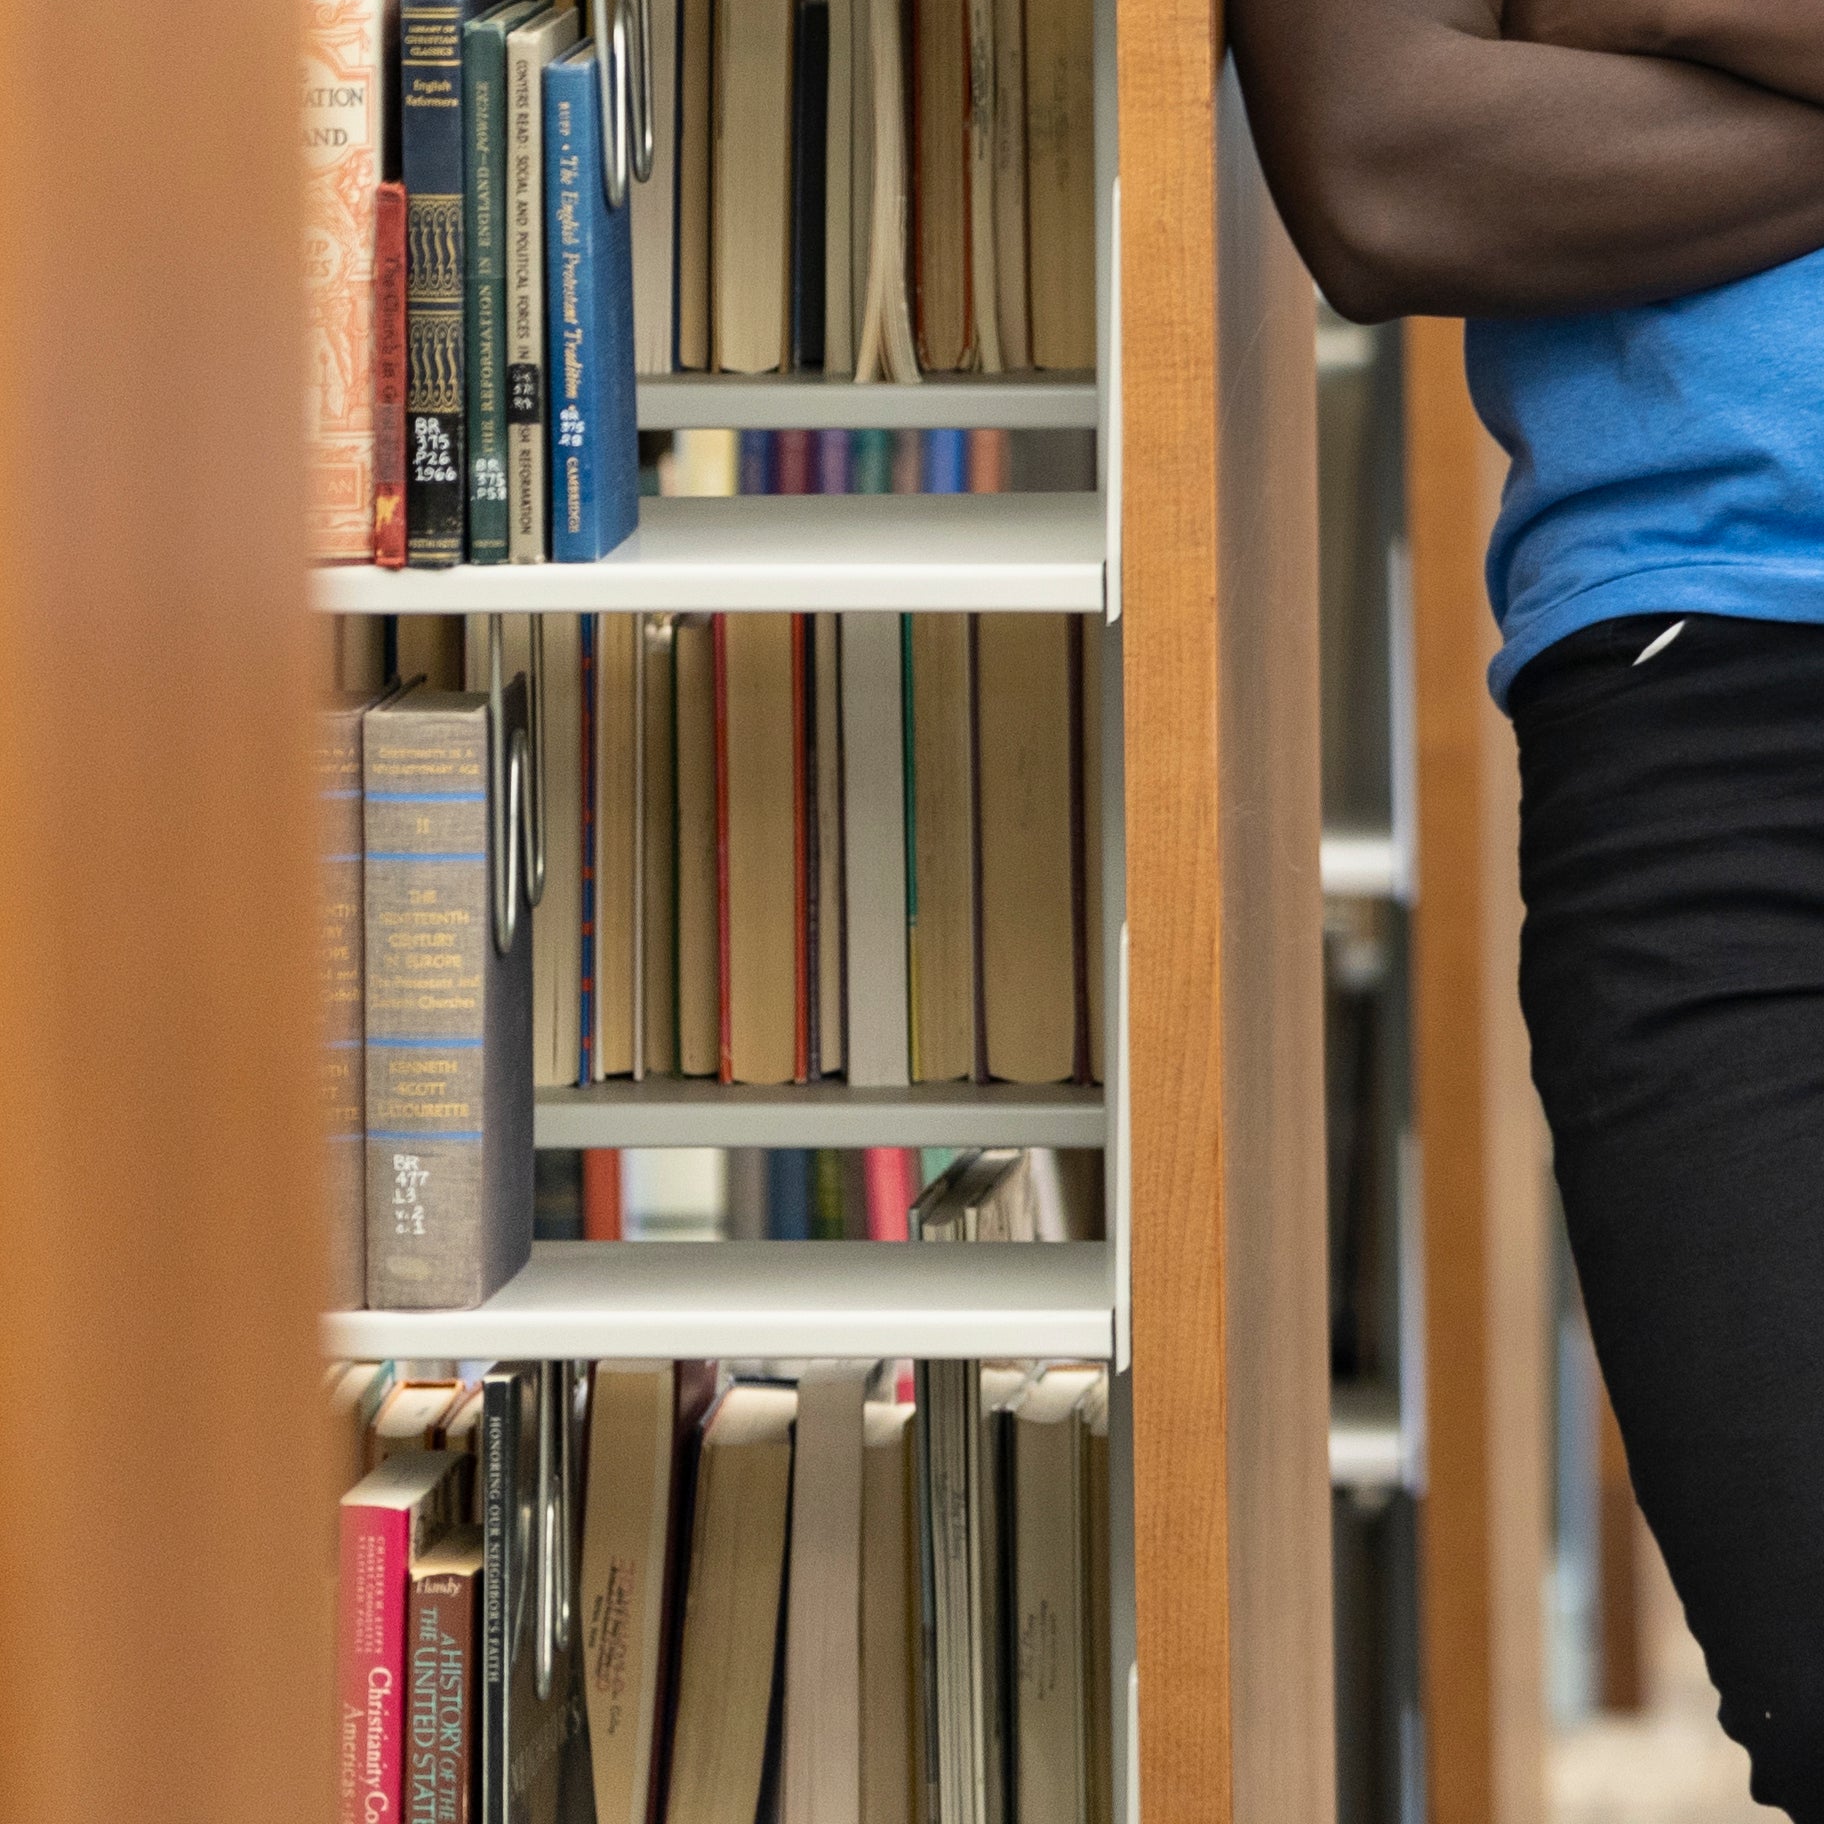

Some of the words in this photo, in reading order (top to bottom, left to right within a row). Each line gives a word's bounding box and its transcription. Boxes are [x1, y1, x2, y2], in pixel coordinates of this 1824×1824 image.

[413, 79, 451, 93] English
[516, 59, 530, 107] CONYERS
[405, 97, 459, 107] Reformers
[517, 155, 530, 195] SOCIAL
[559, 156, 579, 185] The
[518, 198, 532, 226] AND
[558, 191, 579, 250] English
[518, 229, 531, 294] POLITICAL
[517, 296, 532, 341] FORCES
[479, 284, 495, 413] REFORMATION
[517, 346, 532, 360] IN
[563, 328, 583, 399] Tradition
[415, 417, 440, 435] BR
[517, 446, 532, 535] REFORMATION
[389, 1060, 458, 1074] KENNETH
[393, 1154, 419, 1171] BR
[395, 1171, 429, 1187] 477
[489, 1415, 502, 1500] HONORING
[489, 1504, 502, 1537] OUR
[415, 1579, 463, 1597] Handy
[413, 1606, 438, 1641] THE
[440, 1633, 457, 1647] A
[488, 1638, 501, 1683] FAITH
[412, 1647, 438, 1748] UNITED
[440, 1648, 464, 1755] HISTORY
[360, 1666, 392, 1789] Christianity
[439, 1787, 456, 1821] THE
